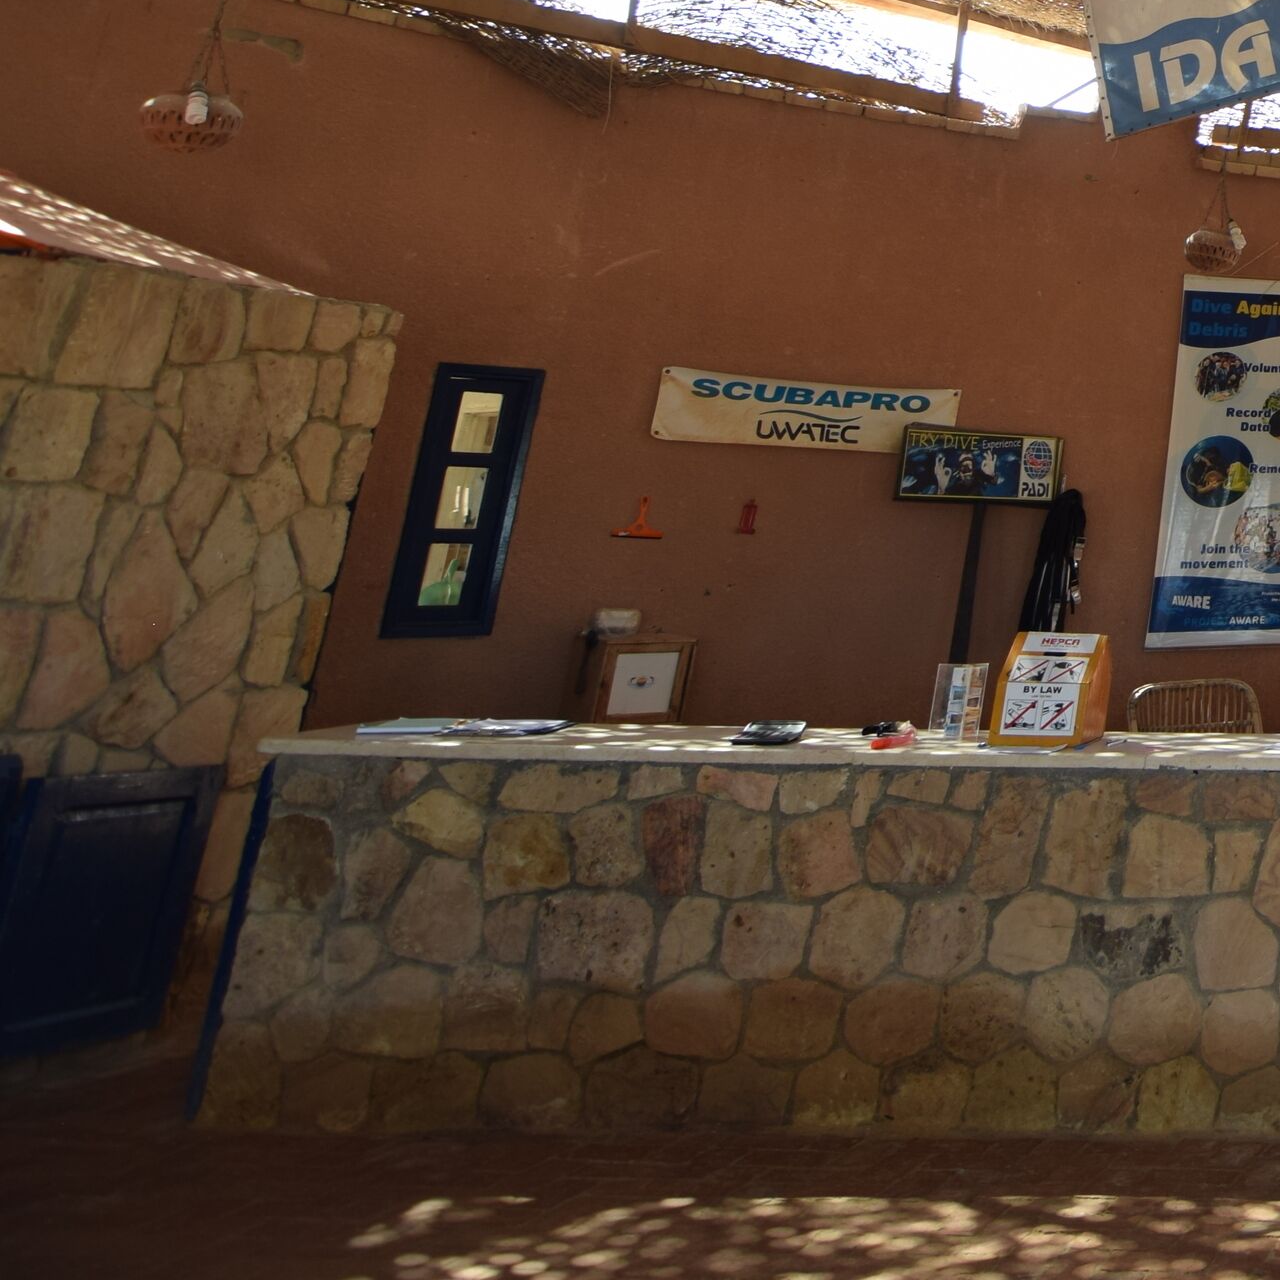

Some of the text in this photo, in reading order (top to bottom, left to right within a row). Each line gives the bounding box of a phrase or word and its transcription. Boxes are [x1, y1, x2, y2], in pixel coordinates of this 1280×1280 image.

[1132, 20, 1276, 112] IDA
[1191, 298, 1232, 315] Dive
[1188, 322, 1248, 338] Debris
[691, 378, 931, 414] SCUBAPRO
[1226, 407, 1273, 418] Record
[756, 420, 861, 444] UWATEC
[1240, 422, 1271, 432] Data
[910, 433, 1022, 450] TRY DIVE Experience
[1021, 482, 1050, 498] PADI
[1200, 544, 1249, 554] Join the
[1180, 560, 1250, 569] movement
[1171, 595, 1211, 610] AWARE
[1023, 686, 1063, 694] BY LAW
